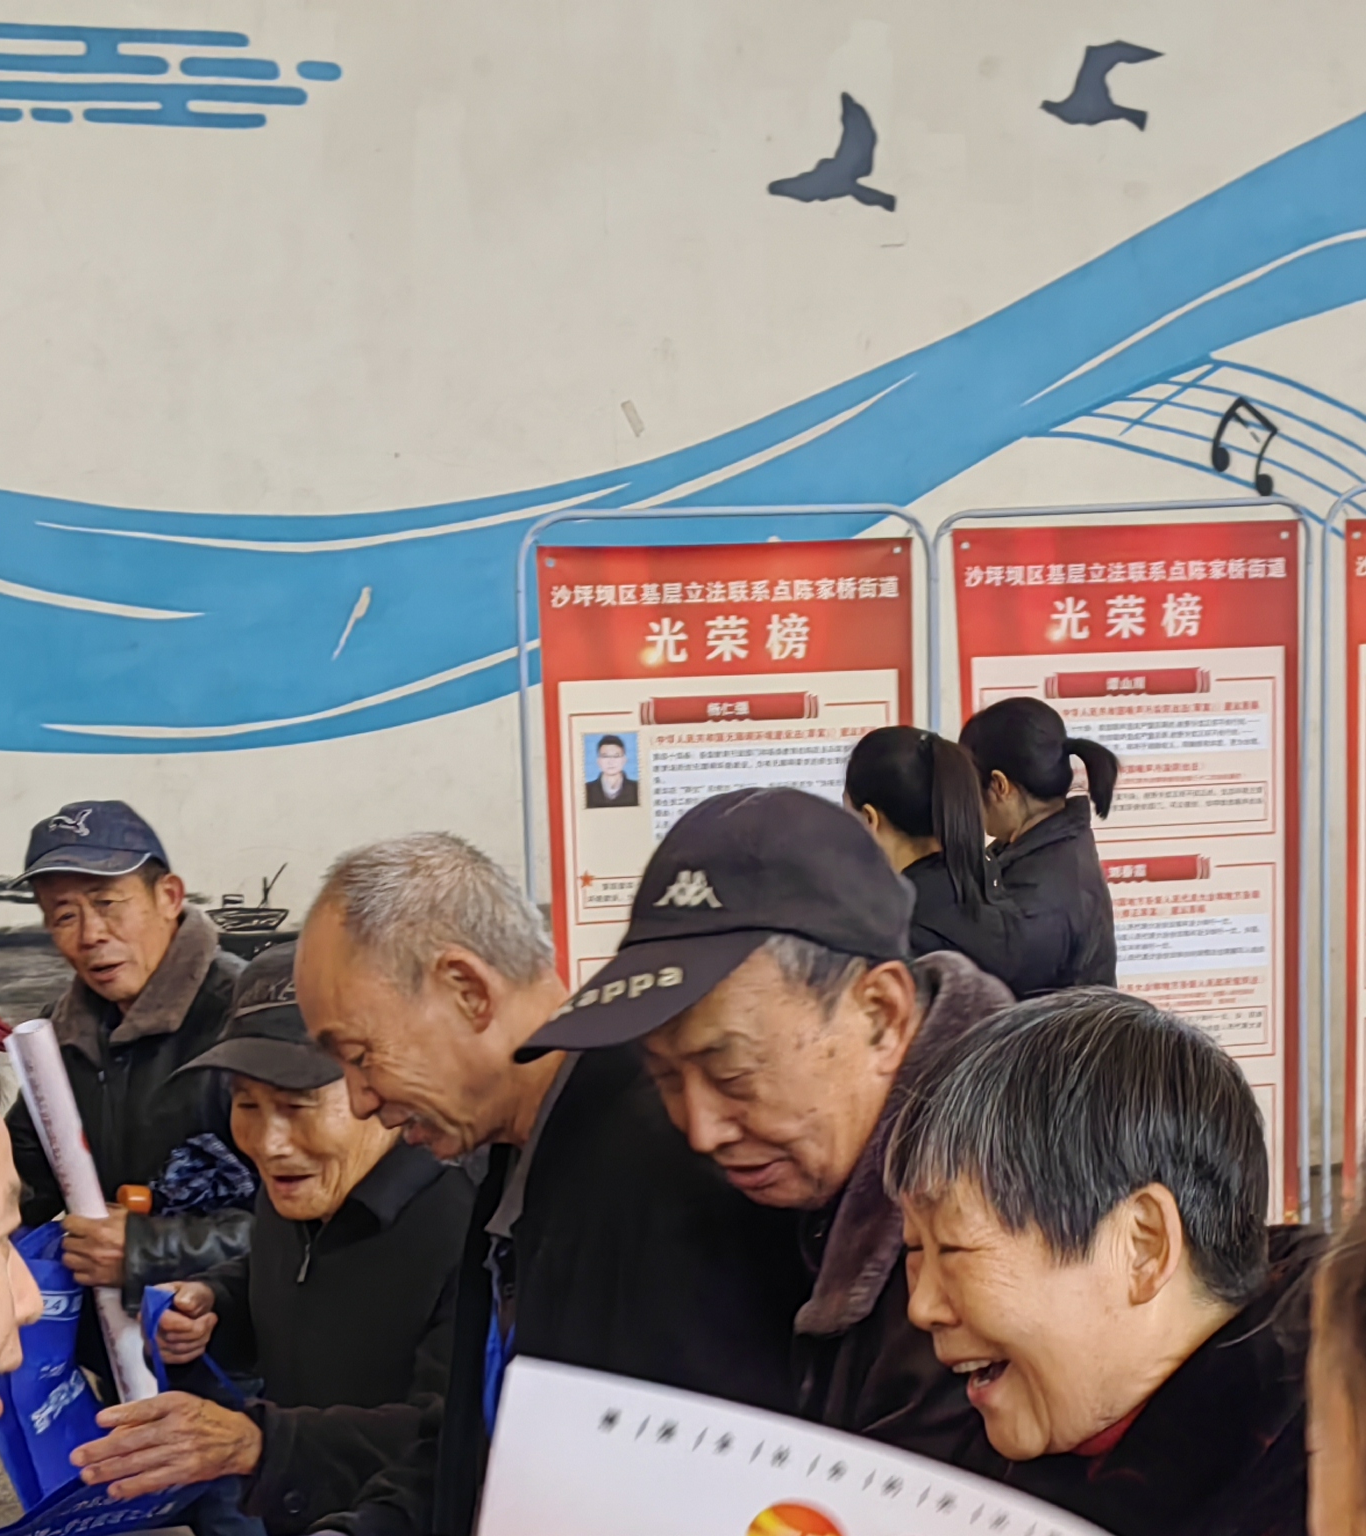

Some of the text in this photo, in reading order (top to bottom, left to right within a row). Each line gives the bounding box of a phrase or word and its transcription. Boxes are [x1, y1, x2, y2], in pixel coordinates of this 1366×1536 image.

[550, 576, 900, 608] 沙坪坝区基层立法联系点陈家桥街道
[965, 557, 1287, 588] 沙坪坝区基层立法联系点陈家桥街道
[1050, 593, 1203, 640] 光荣榜
[645, 613, 811, 663] 光荣榜
